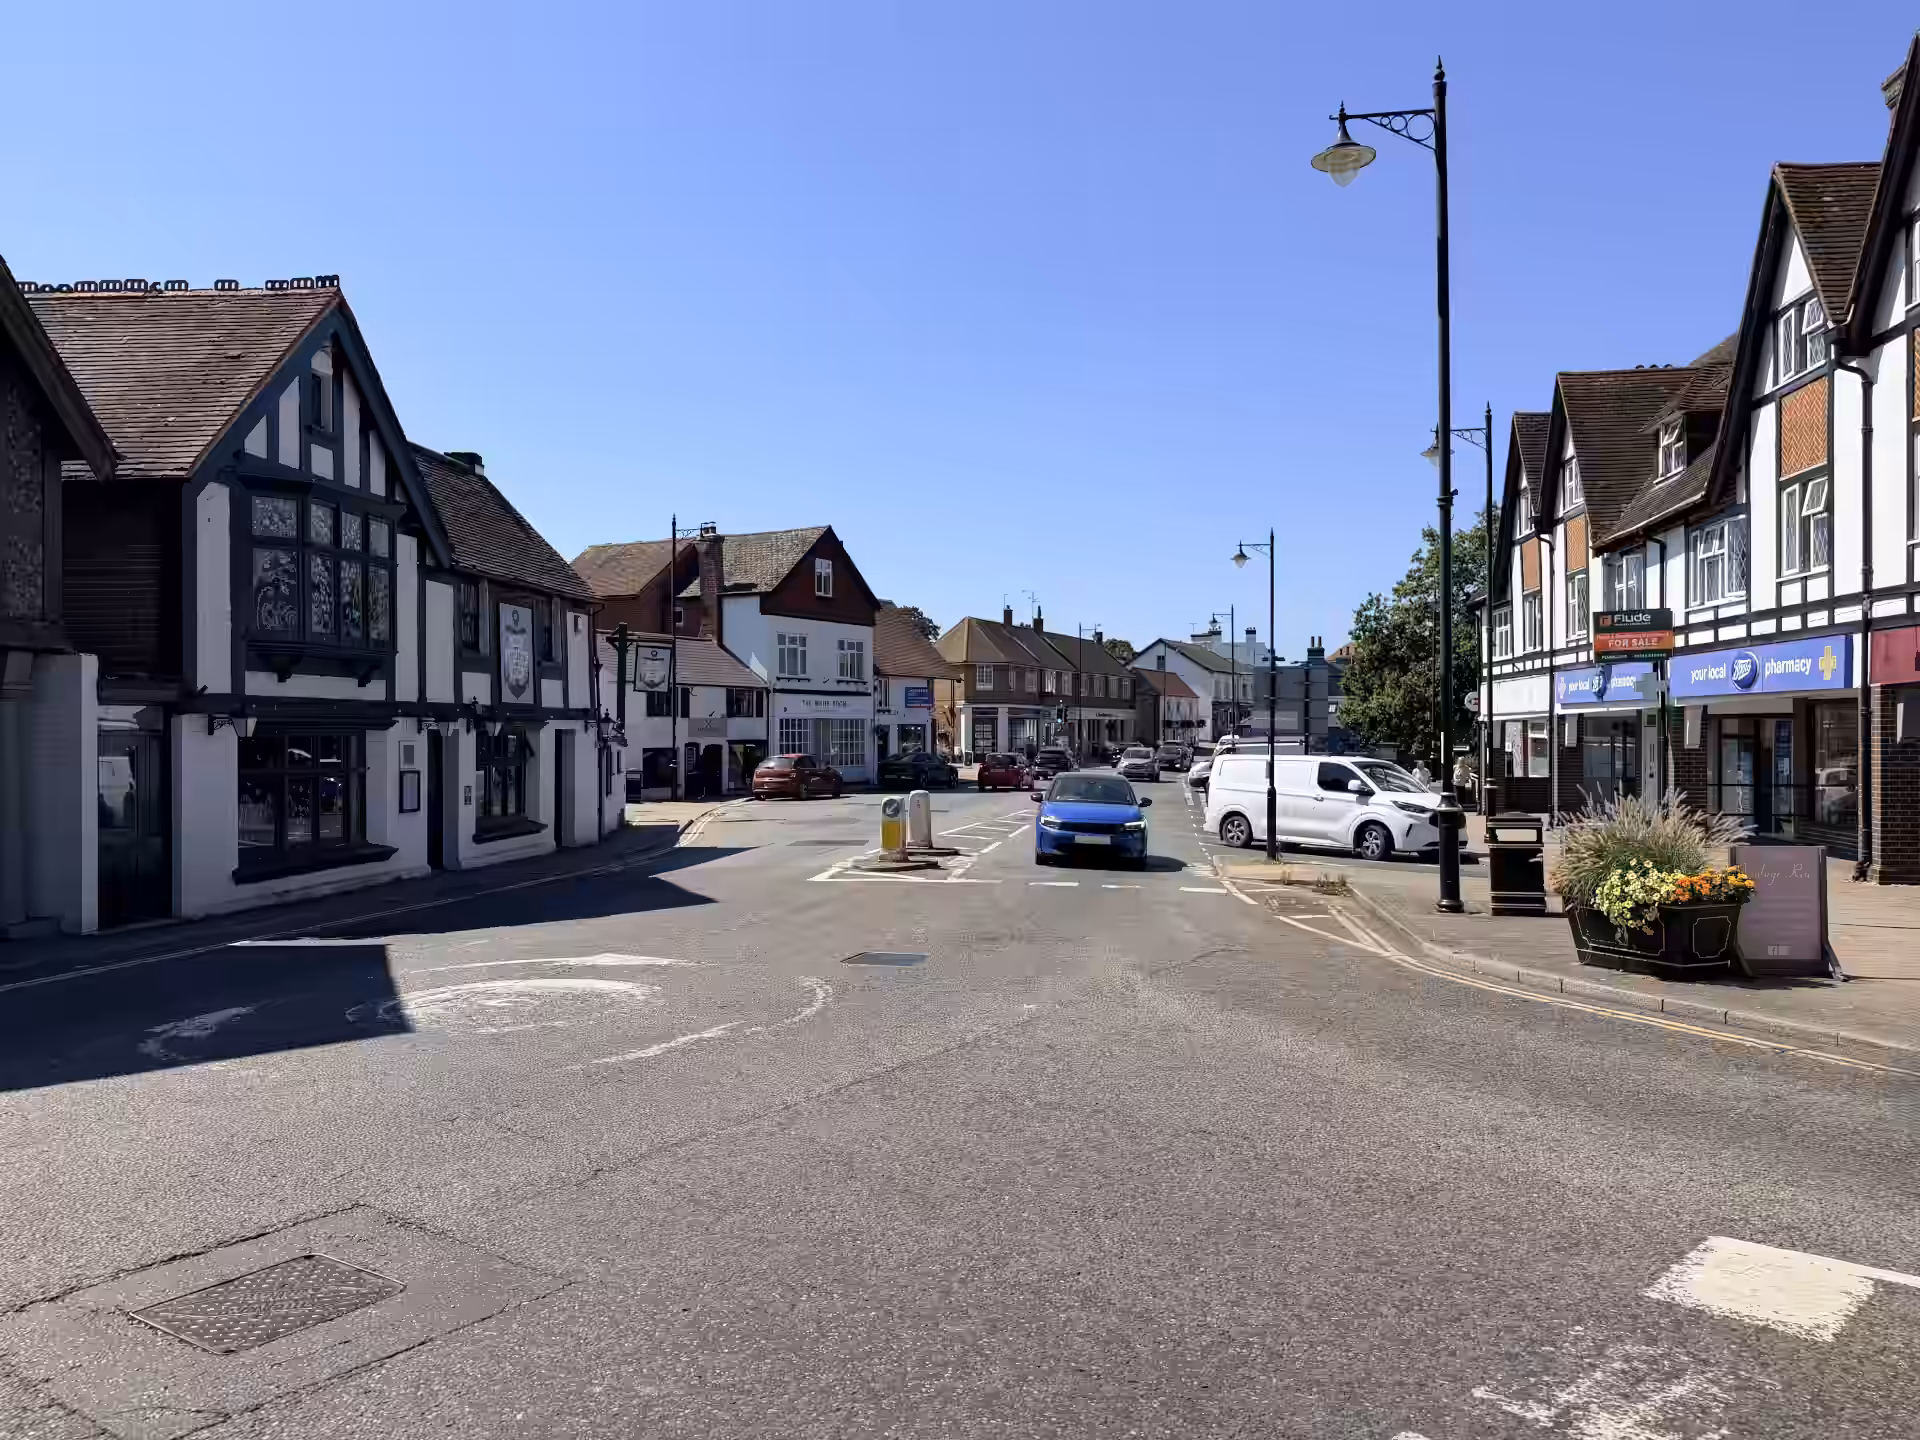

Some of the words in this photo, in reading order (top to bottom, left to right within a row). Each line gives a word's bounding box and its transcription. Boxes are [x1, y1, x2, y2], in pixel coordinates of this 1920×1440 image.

[1613, 613, 1651, 623] Flude
[1608, 639, 1629, 648] FOR
[1631, 637, 1659, 647] SALE
[1690, 667, 1707, 684] your
[1708, 662, 1726, 680] local
[1764, 657, 1812, 678] pharmacy
